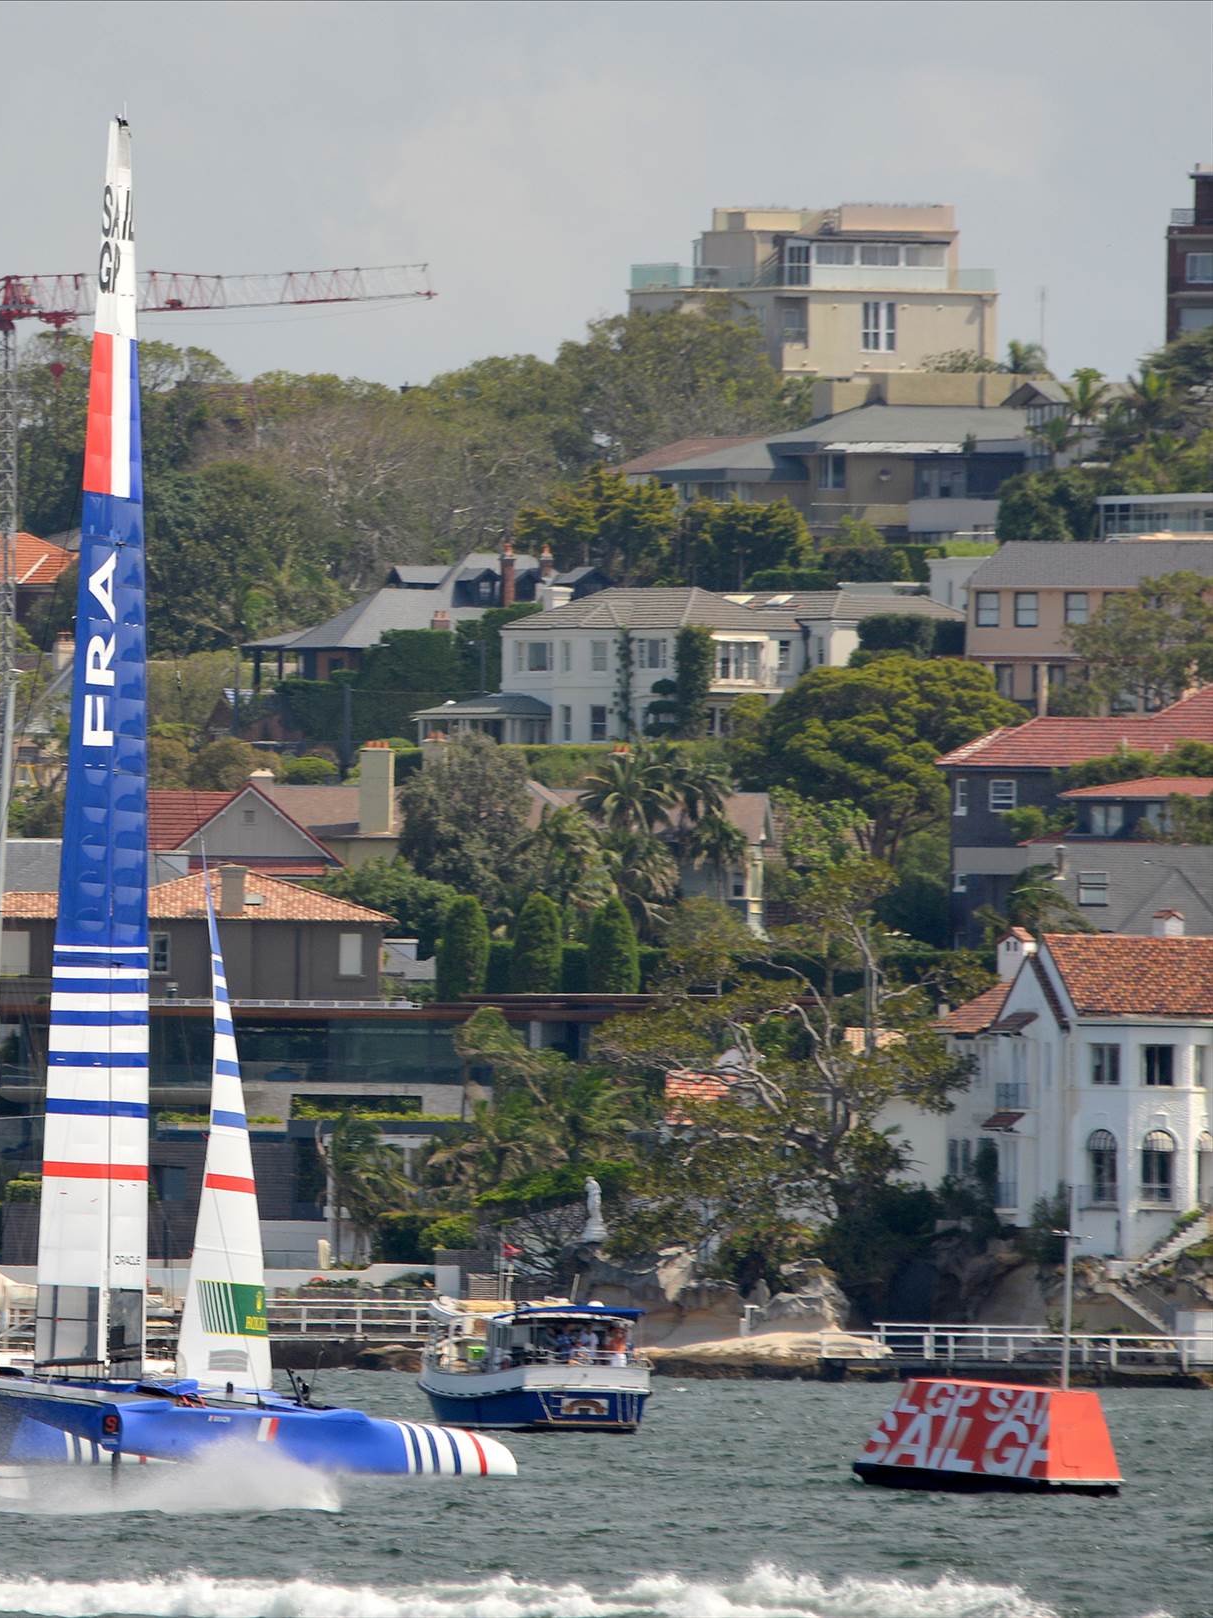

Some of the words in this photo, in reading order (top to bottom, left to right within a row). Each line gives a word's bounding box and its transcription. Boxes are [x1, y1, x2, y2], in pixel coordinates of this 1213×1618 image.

[102, 185, 135, 241] SAIL
[99, 241, 121, 294] GP
[82, 551, 117, 746] FRA
[114, 1255, 141, 1266] ORACLE
[924, 1382, 979, 1417] GP
[856, 1411, 976, 1473] SAIL
